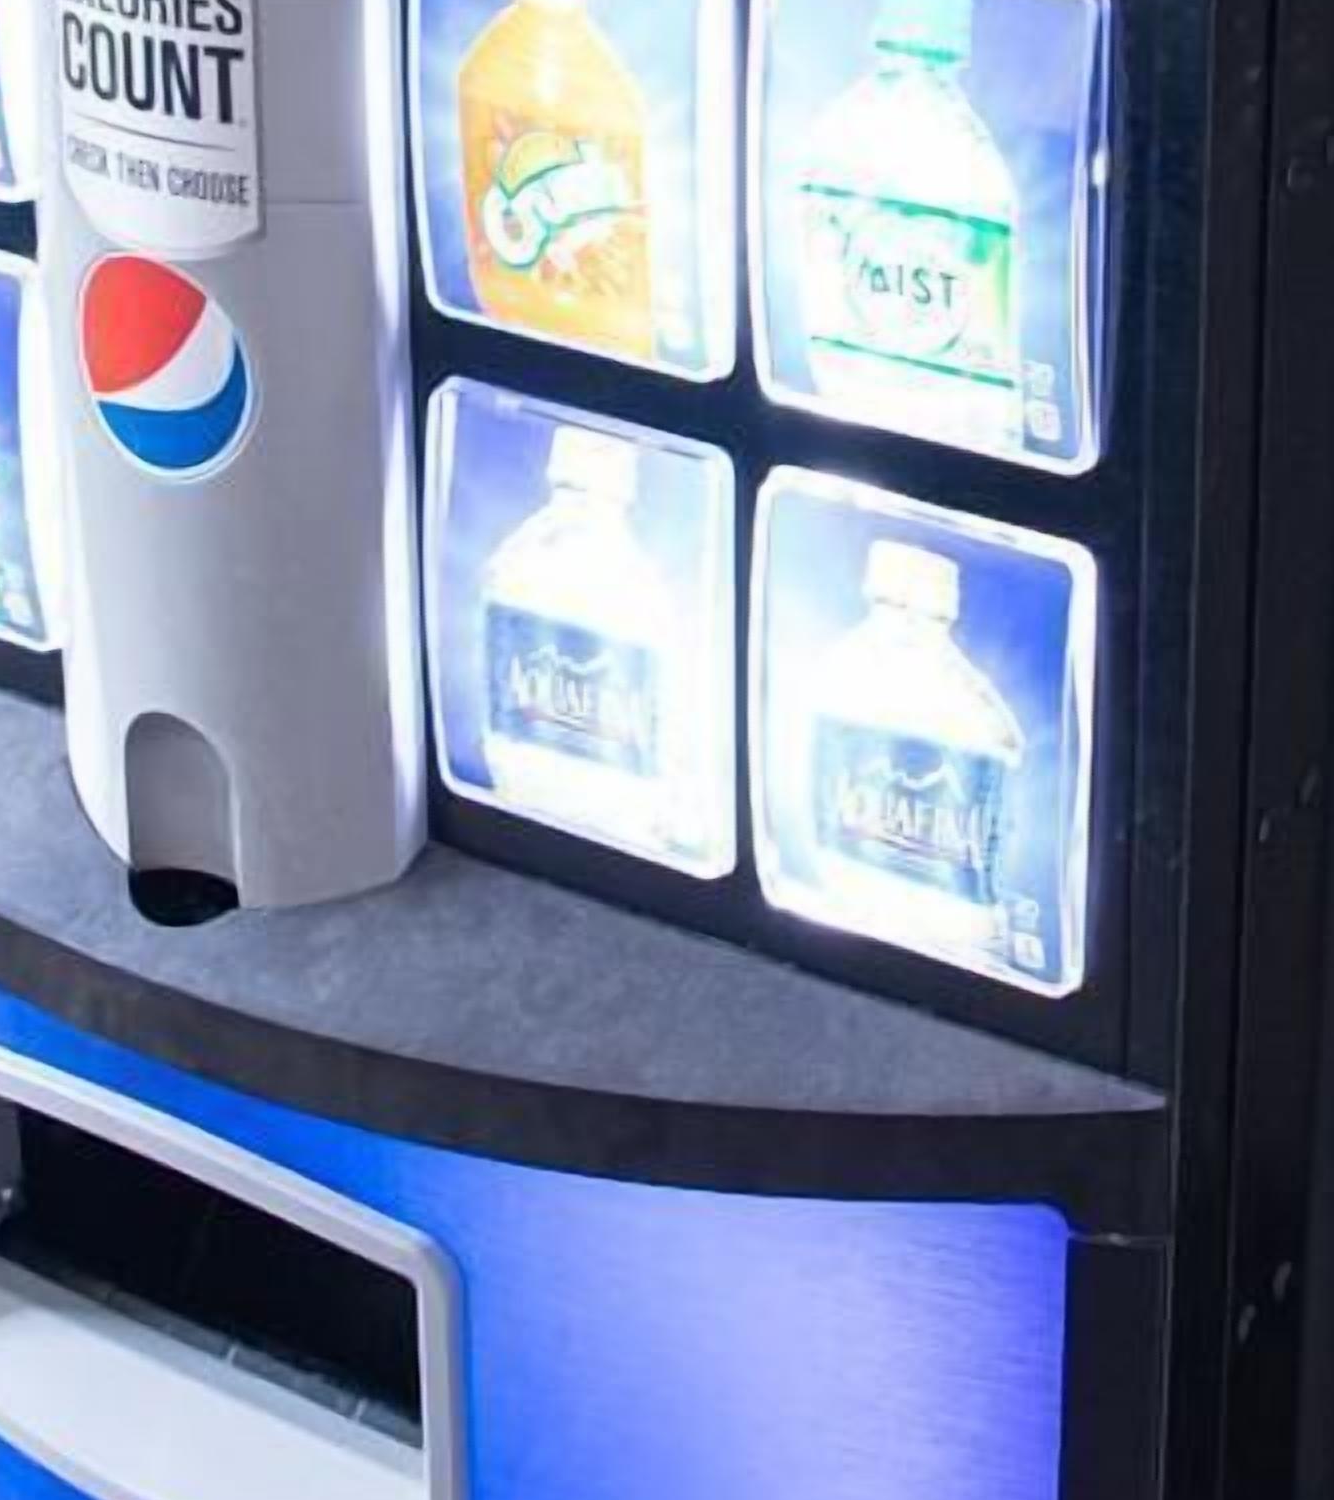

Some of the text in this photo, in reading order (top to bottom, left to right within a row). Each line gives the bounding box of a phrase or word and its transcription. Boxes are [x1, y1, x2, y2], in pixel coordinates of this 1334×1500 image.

[61, 9, 244, 125] COUNT
[117, 151, 160, 191] THEN
[168, 165, 249, 205] CHOOSE
